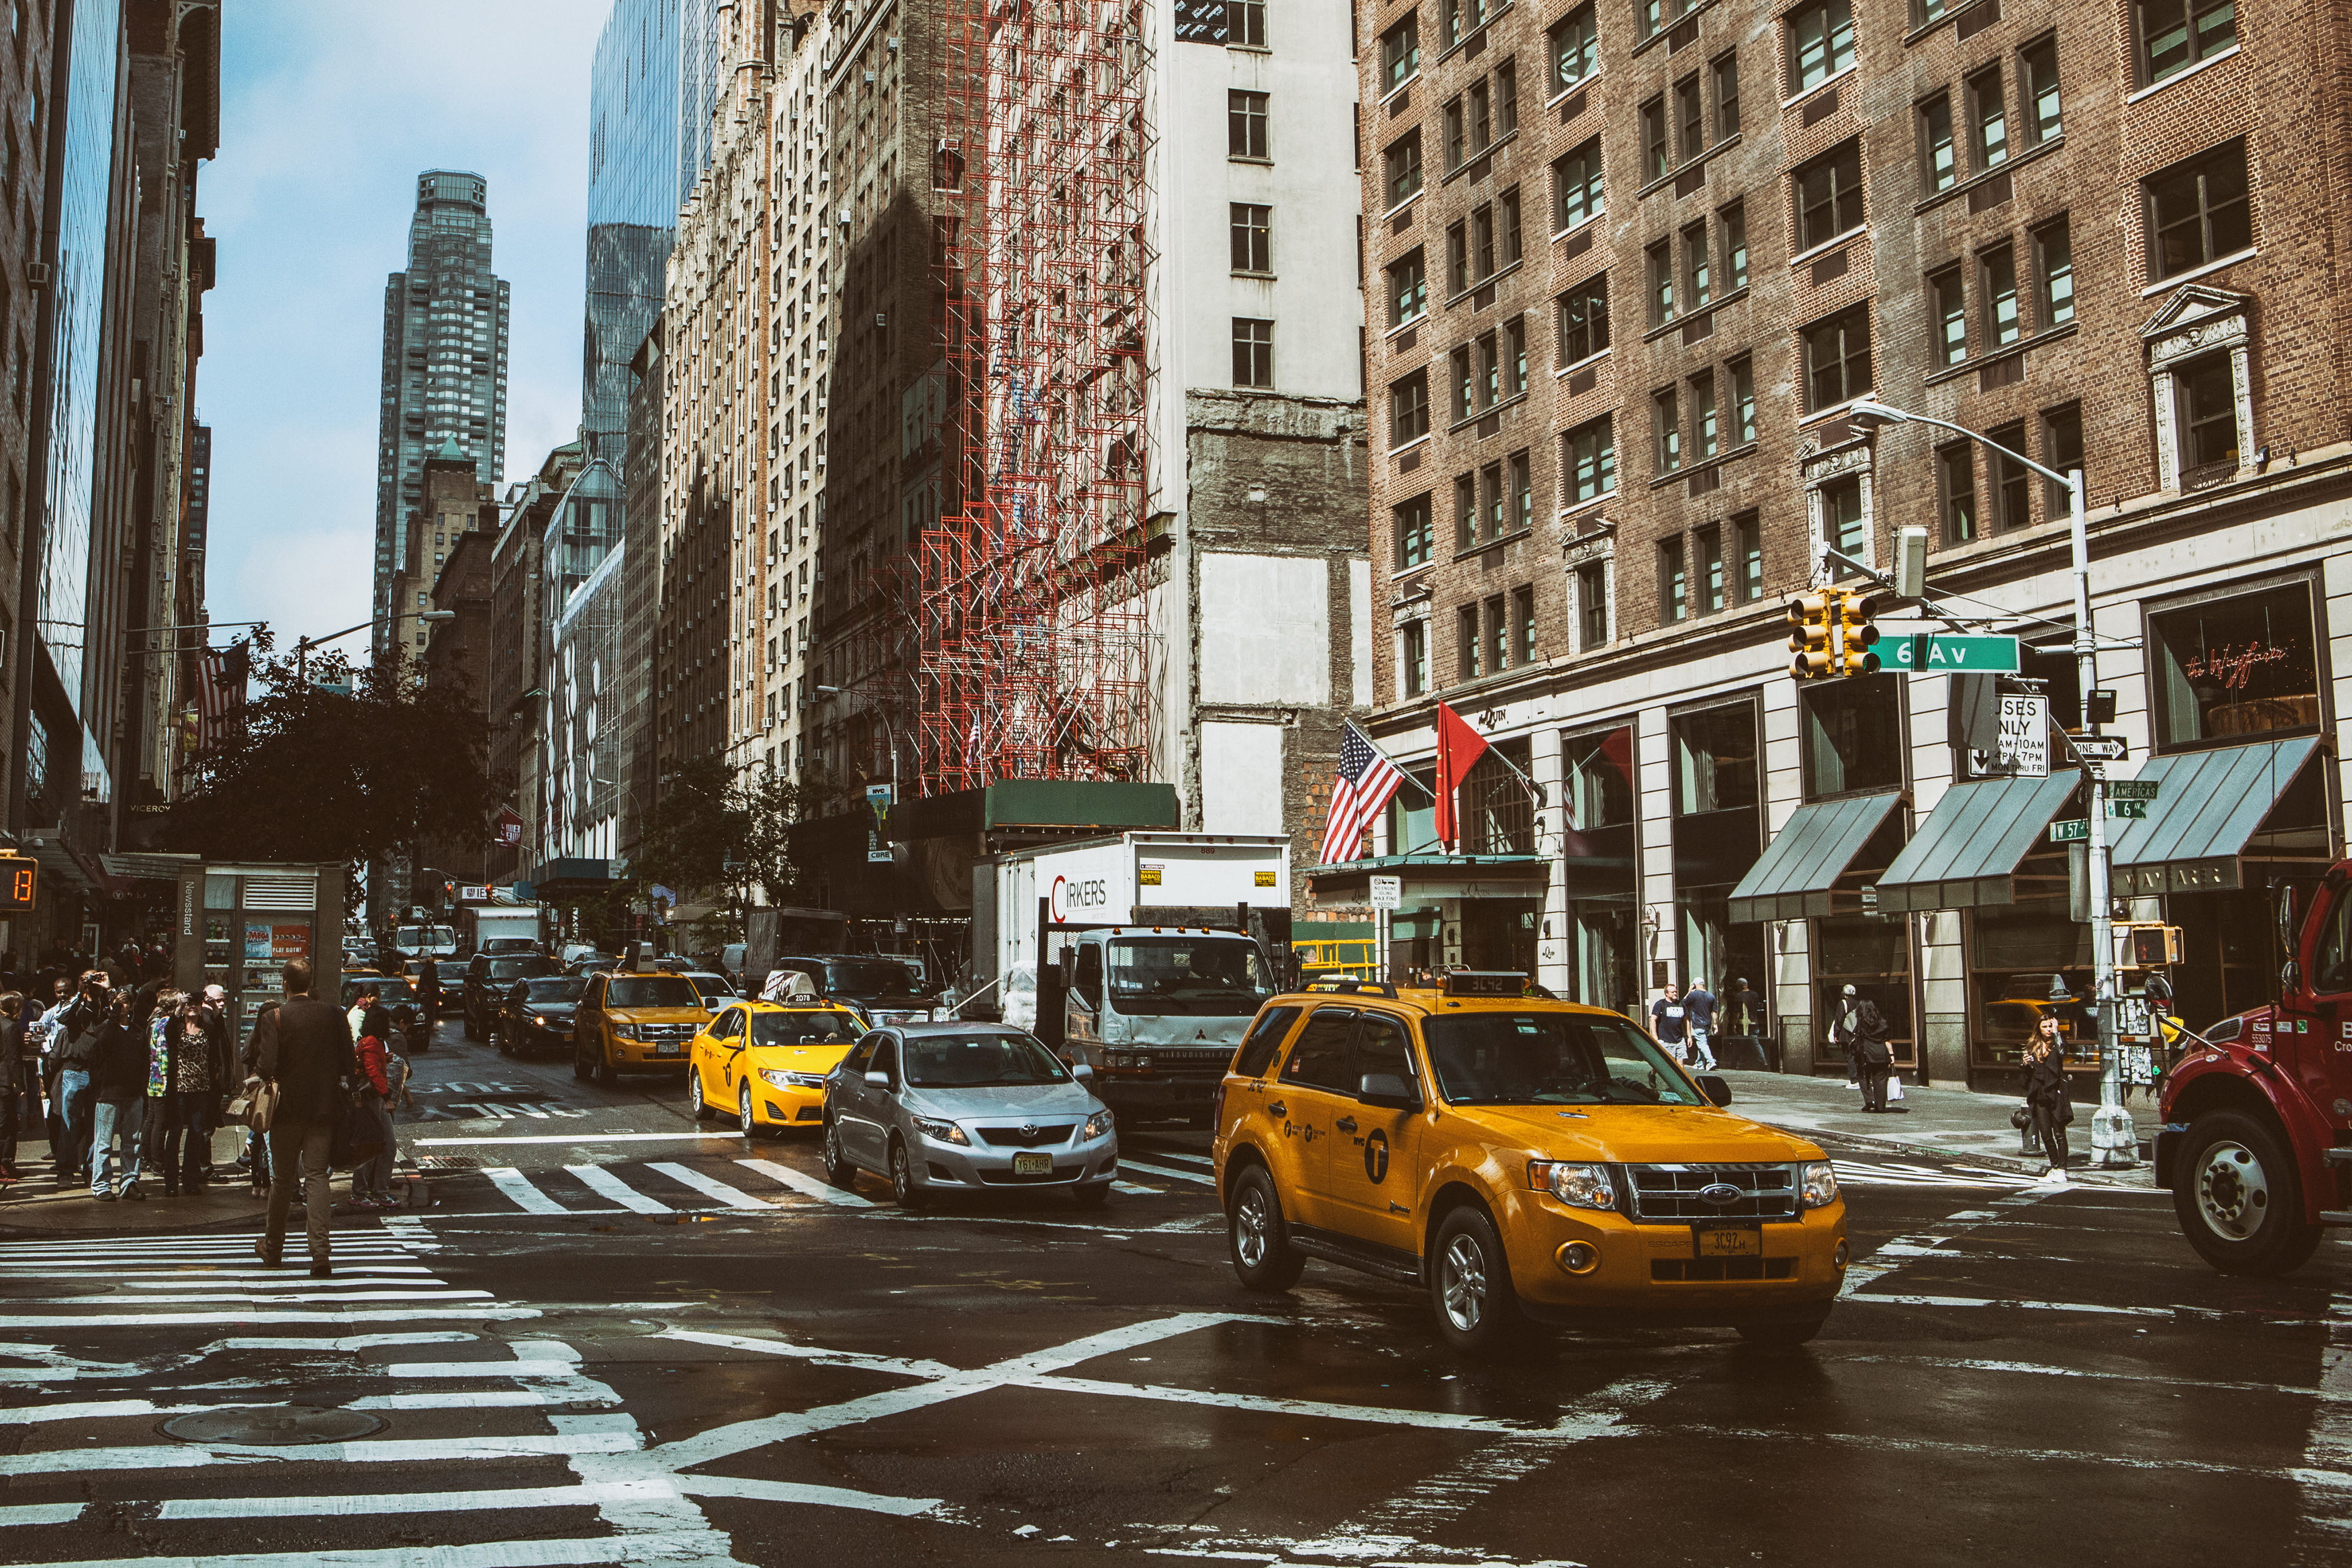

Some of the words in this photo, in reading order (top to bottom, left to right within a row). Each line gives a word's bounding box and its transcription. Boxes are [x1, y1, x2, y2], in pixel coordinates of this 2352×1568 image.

[1897, 643, 1912, 663] 6
[1995, 700, 2036, 716] USES
[1999, 720, 2030, 735] NLY
[2076, 744, 2094, 753] ONE
[2102, 744, 2119, 754] WAY
[1991, 763, 2009, 771] MON
[2116, 788, 2155, 797] AMERICAS
[130, 804, 171, 813] VICEROY
[2124, 803, 2131, 816] 6
[2057, 825, 2063, 838] W
[2068, 823, 2078, 837] 57
[2126, 868, 2221, 888] WAYARER
[14, 870, 32, 901] 13
[184, 881, 195, 935] Newsstand
[248, 931, 269, 940] MEGA
[1472, 977, 1503, 991] 3C92
[2252, 1034, 2272, 1044] 553075
[1354, 1136, 1365, 1146] NYC
[1713, 1189, 1732, 1198] Ford
